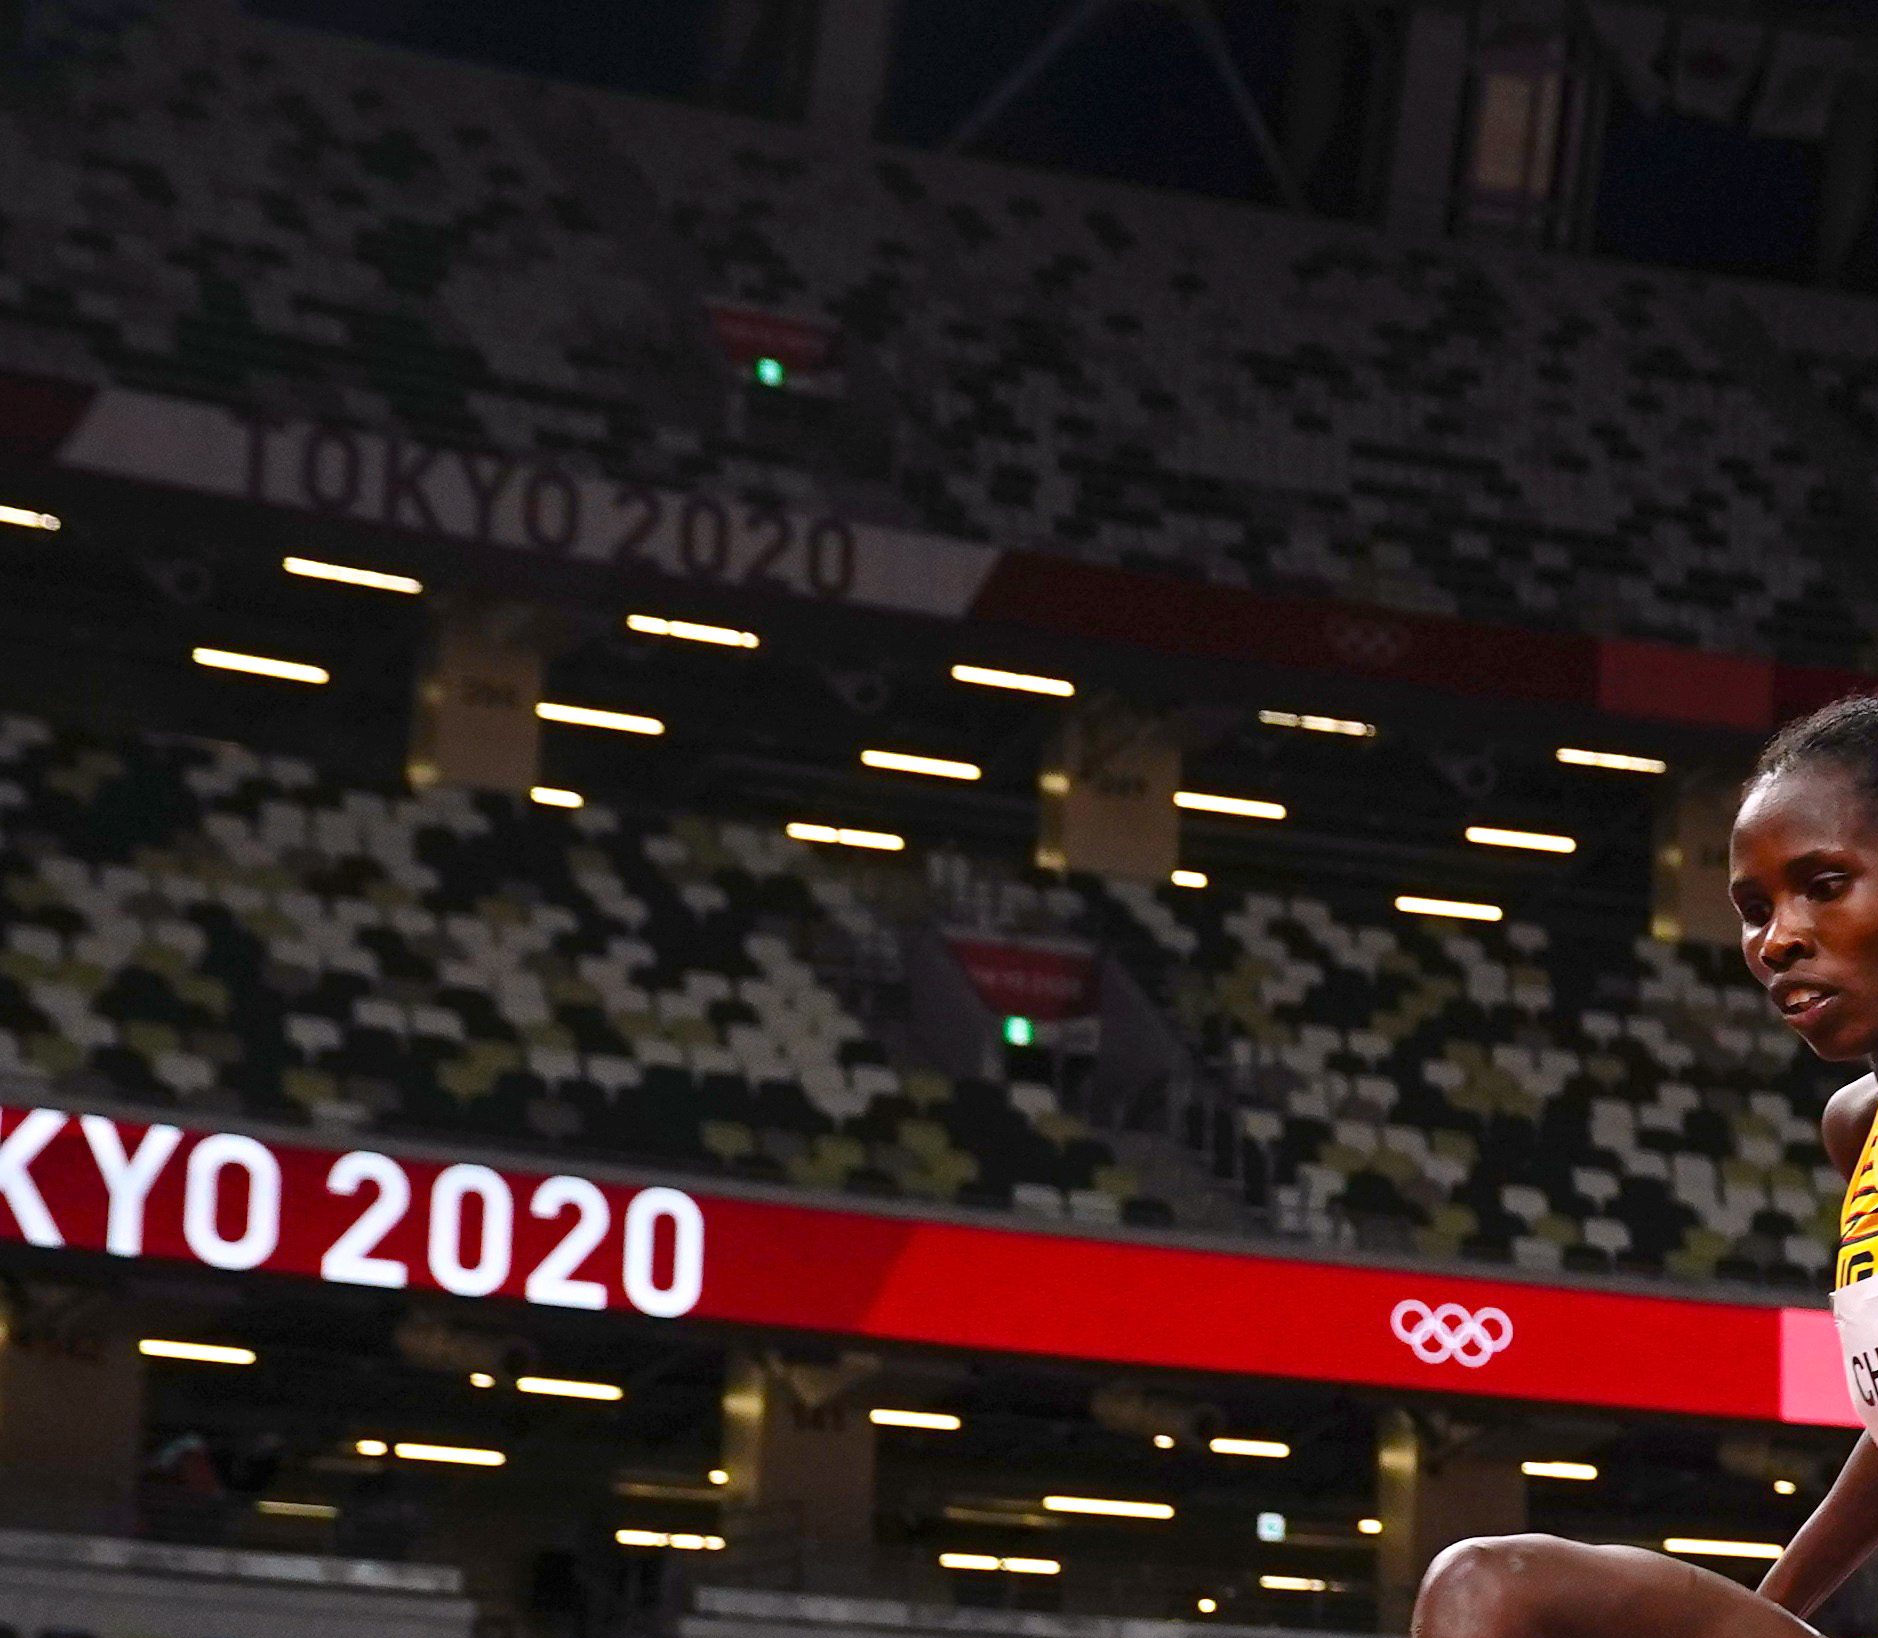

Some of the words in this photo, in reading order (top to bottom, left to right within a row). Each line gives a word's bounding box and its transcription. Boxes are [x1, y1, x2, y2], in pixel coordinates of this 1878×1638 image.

[230, 412, 578, 554] TOKYO
[612, 478, 857, 598] 2020
[321, 1149, 706, 1319] 2020
